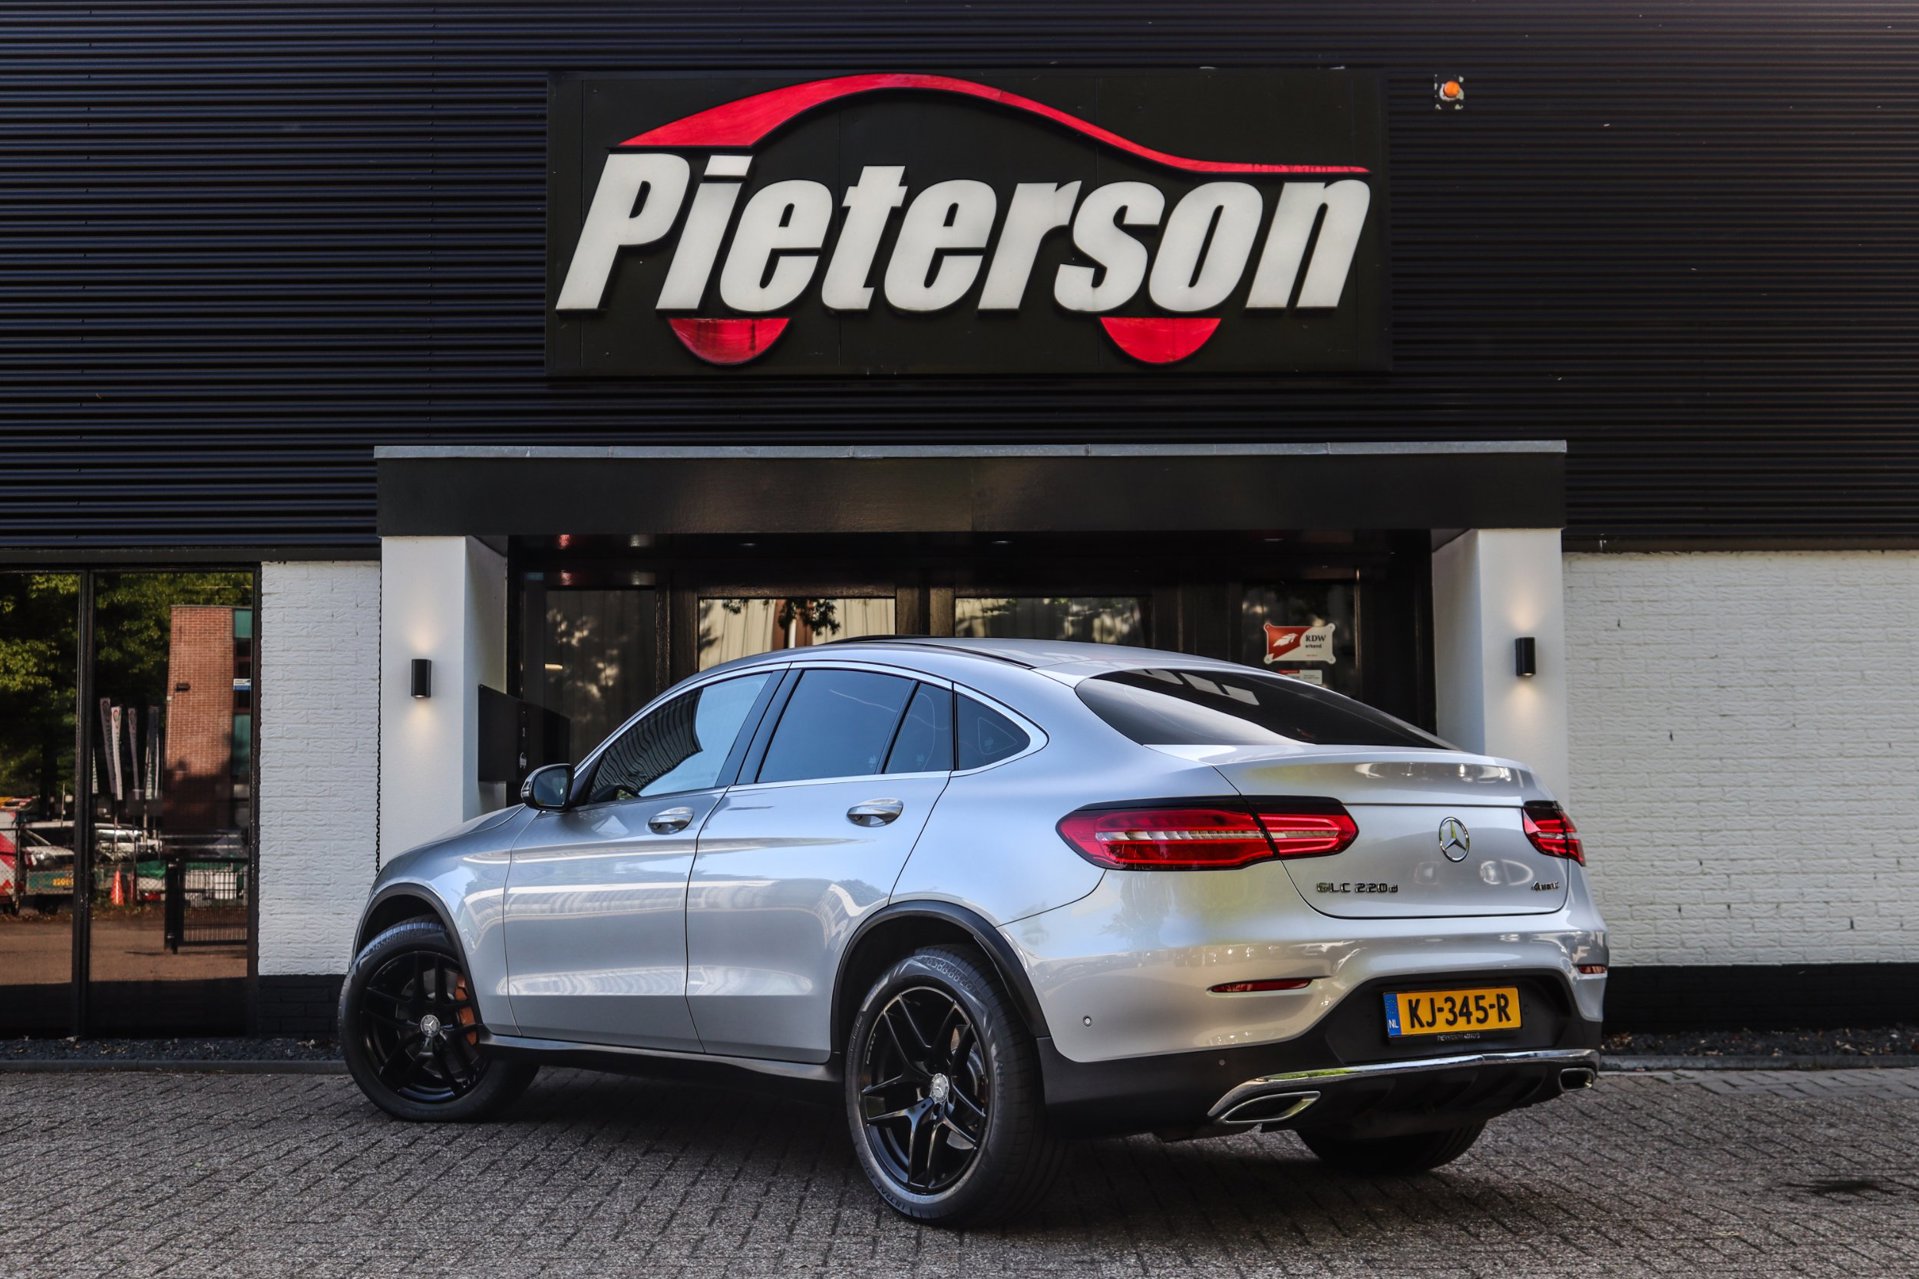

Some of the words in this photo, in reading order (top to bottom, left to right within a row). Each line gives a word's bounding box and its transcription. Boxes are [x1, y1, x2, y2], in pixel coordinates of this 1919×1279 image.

[555, 152, 1371, 313] Pieterson
[1316, 882, 1351, 893] GLC
[1407, 993, 1512, 1029] KJ-345-R
[1388, 1018, 1399, 1029] NL
